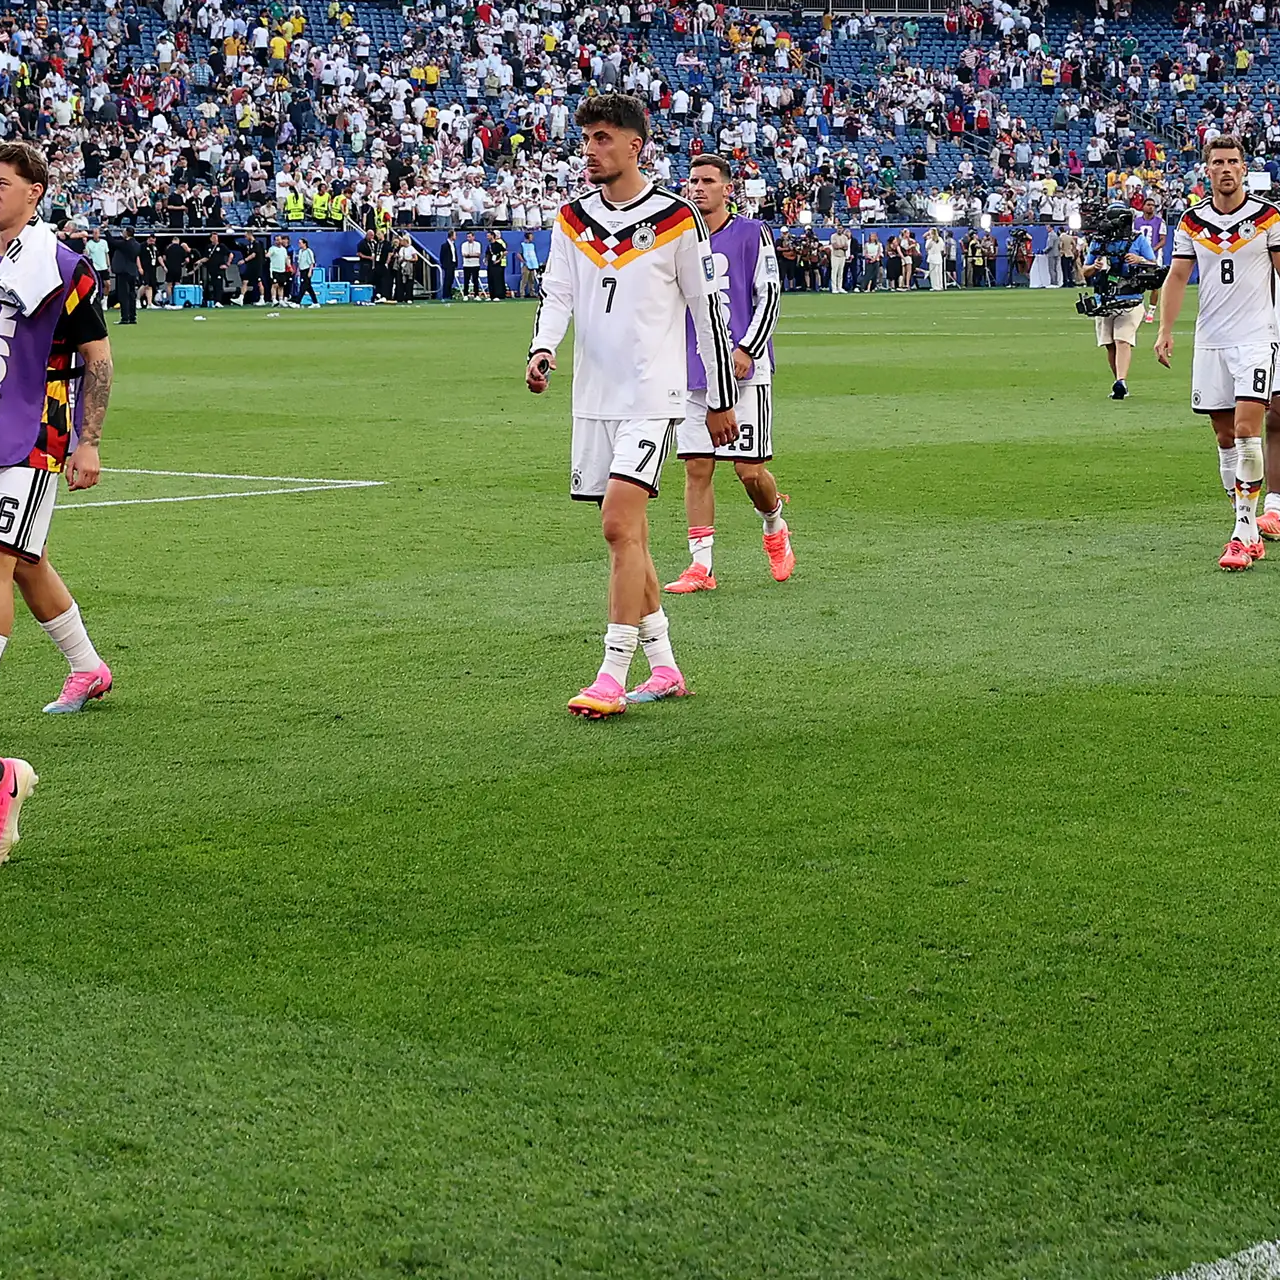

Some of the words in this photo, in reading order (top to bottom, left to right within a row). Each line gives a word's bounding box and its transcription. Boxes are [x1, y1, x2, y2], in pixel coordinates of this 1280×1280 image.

[1220, 258, 1235, 284] 8
[601, 277, 617, 313] 7
[1252, 368, 1267, 394] 8
[637, 439, 657, 473] 7
